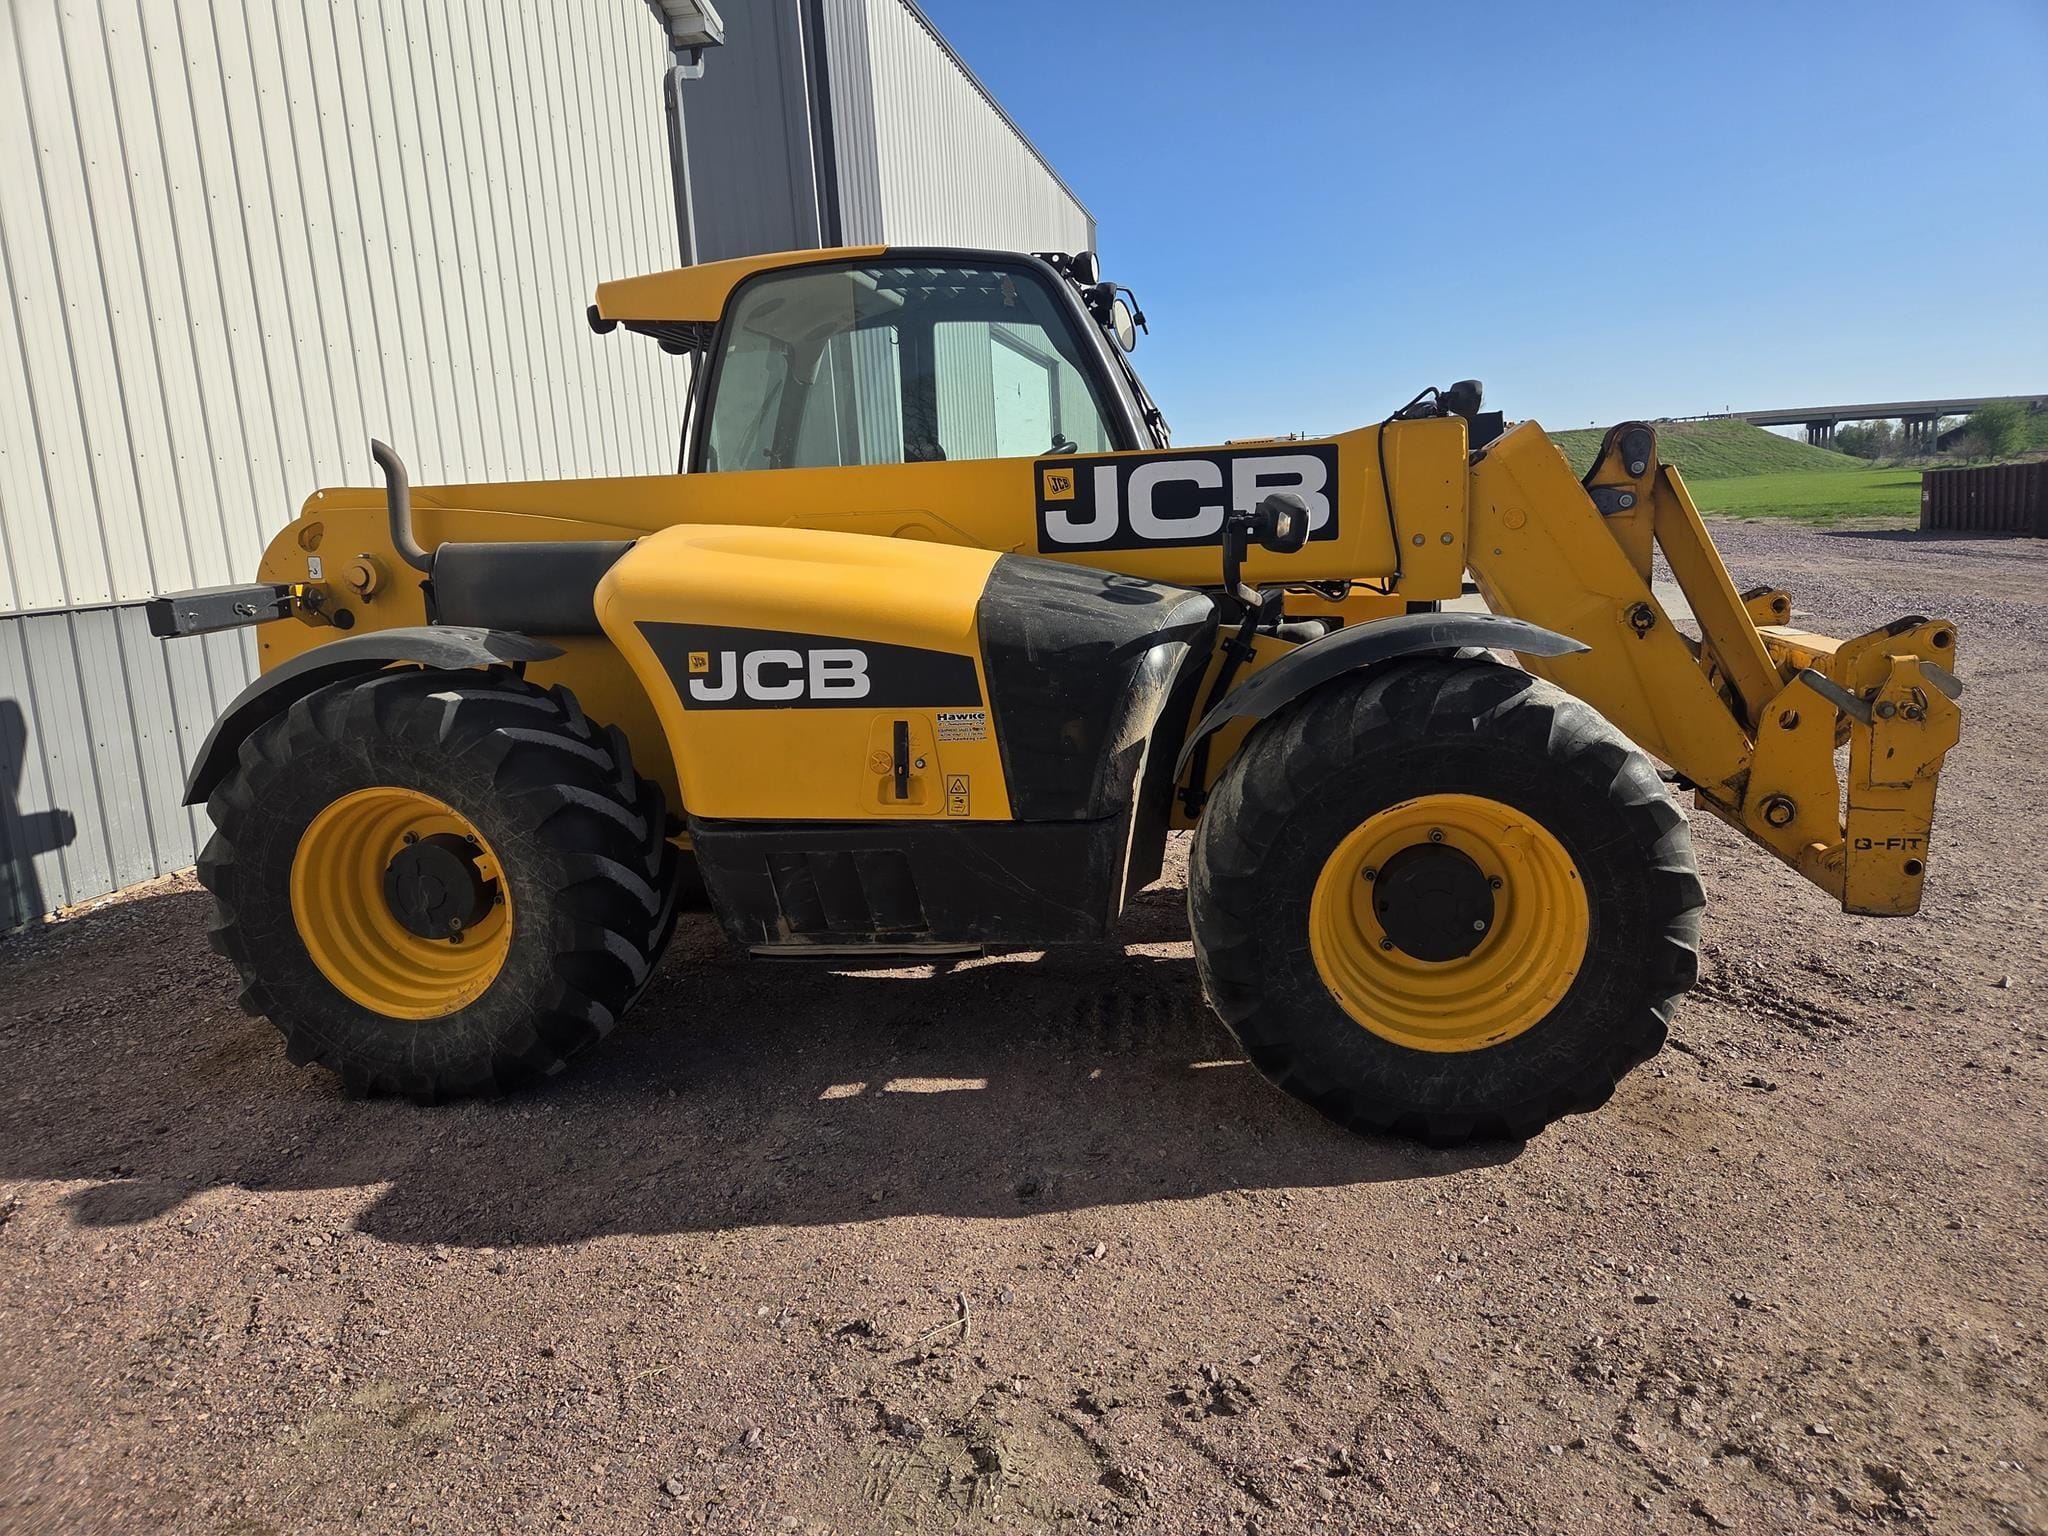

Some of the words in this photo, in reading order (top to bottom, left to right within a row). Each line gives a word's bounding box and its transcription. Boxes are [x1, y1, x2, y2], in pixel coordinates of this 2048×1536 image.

[1045, 454, 1330, 543] JCB
[1050, 475, 1071, 492] JCB
[689, 649, 870, 701] JCB
[1855, 838, 1922, 850] Q-FIT
